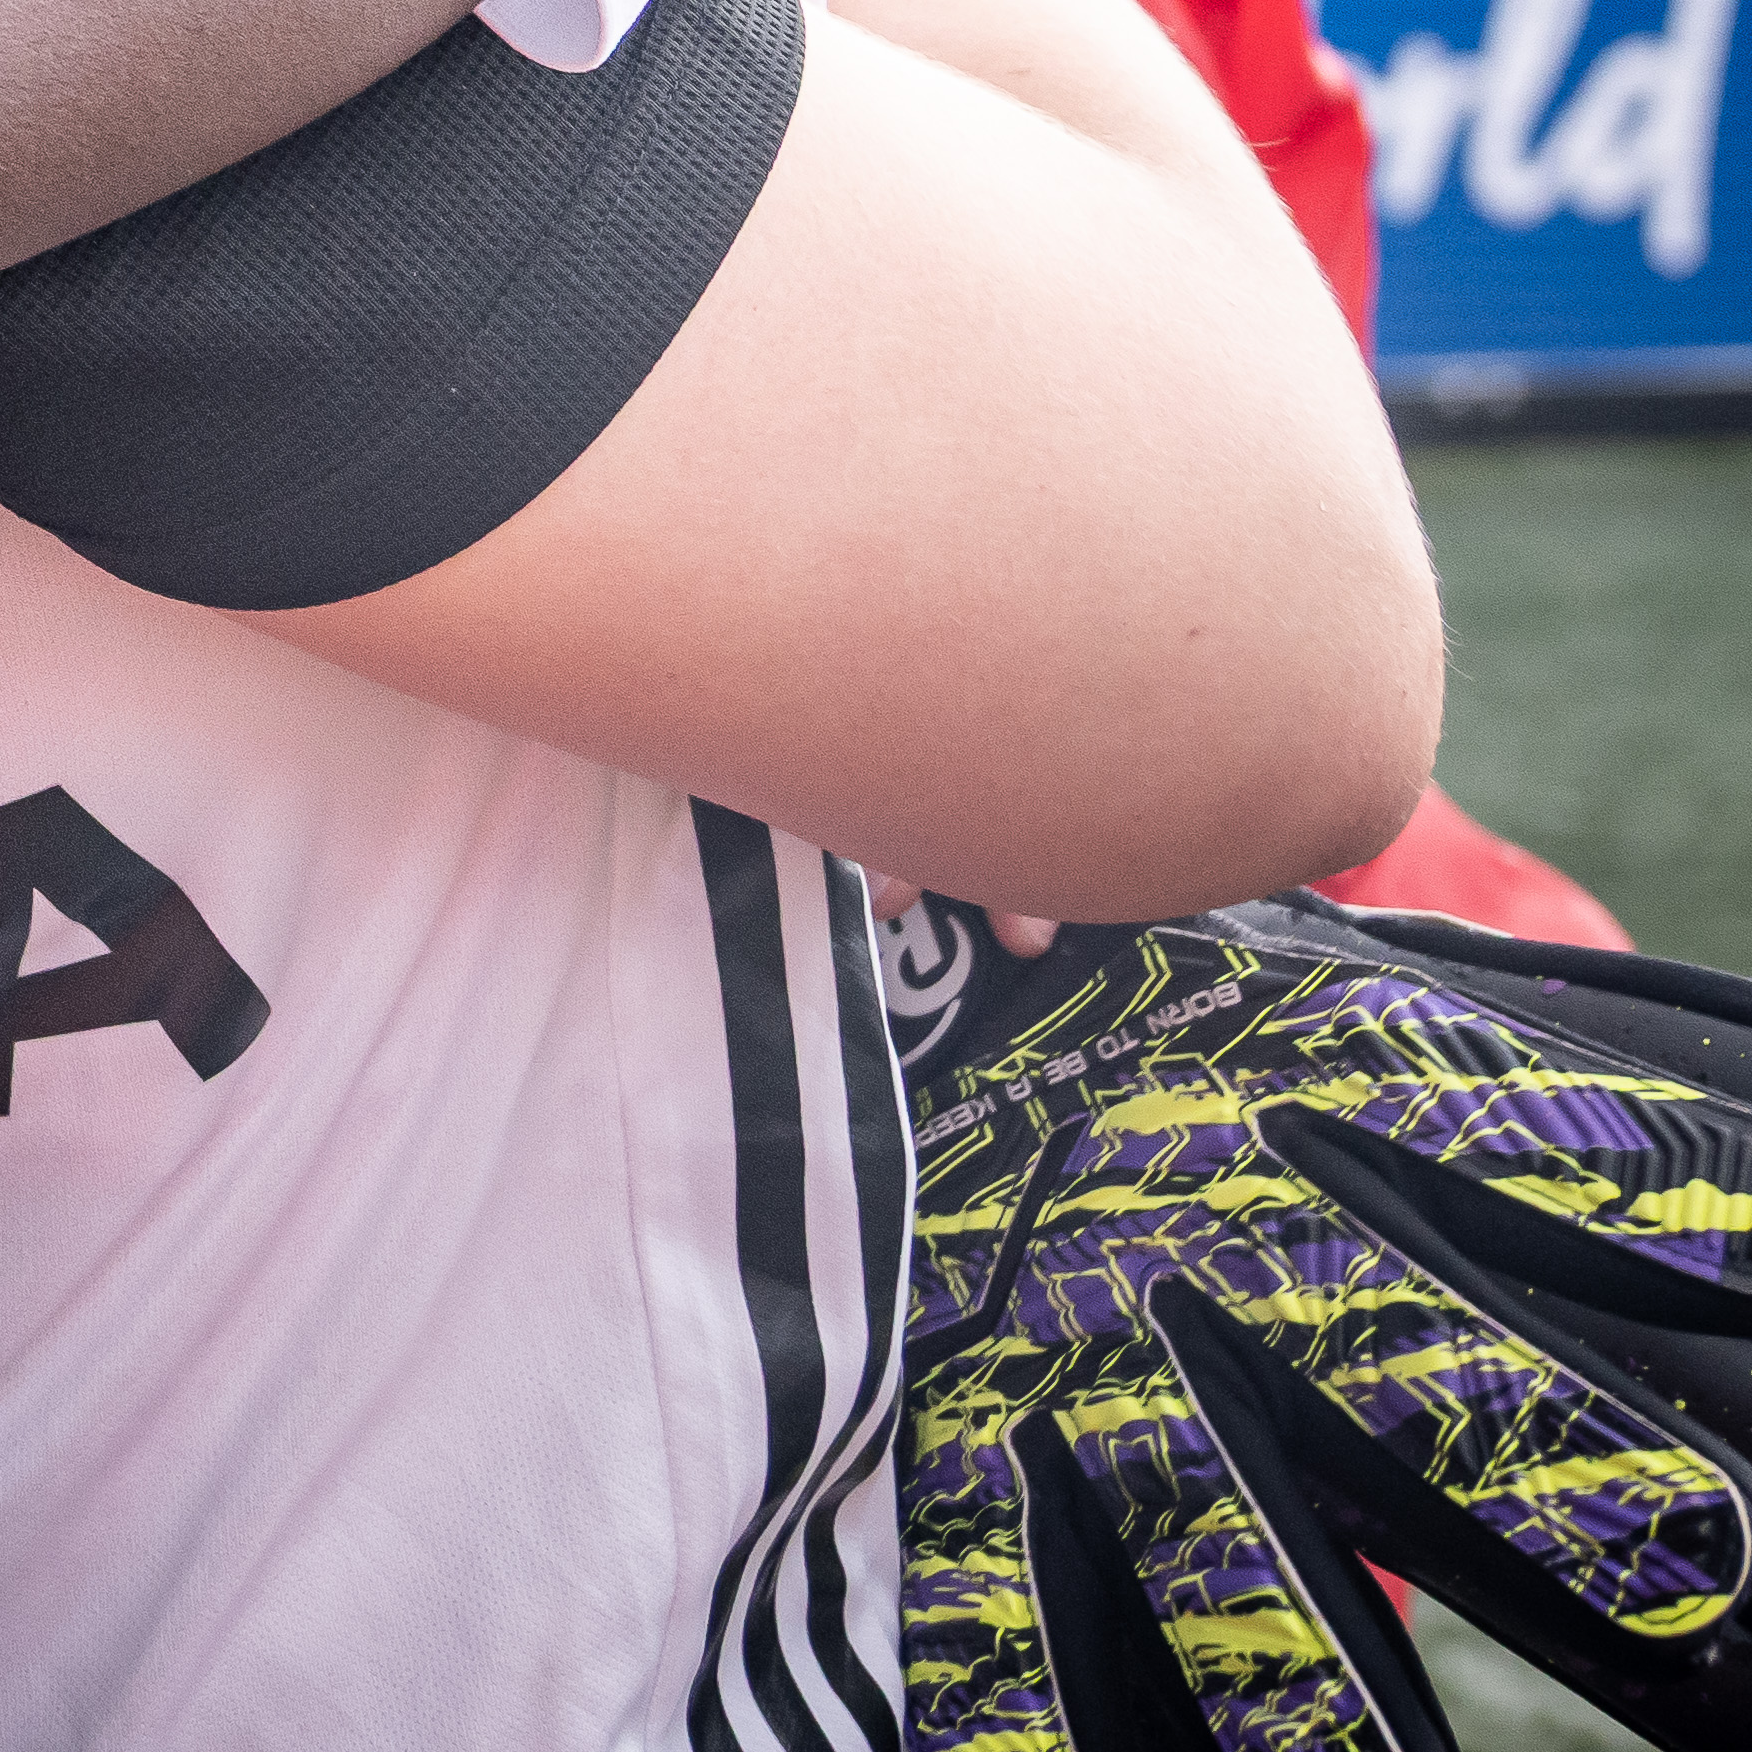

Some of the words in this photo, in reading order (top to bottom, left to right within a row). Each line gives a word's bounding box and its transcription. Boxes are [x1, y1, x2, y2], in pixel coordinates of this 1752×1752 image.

[1146, 981, 1243, 1036] BORN
[1096, 1027, 1140, 1062] TO
[1043, 1050, 1087, 1086] BE
[1005, 1075, 1033, 1102] A
